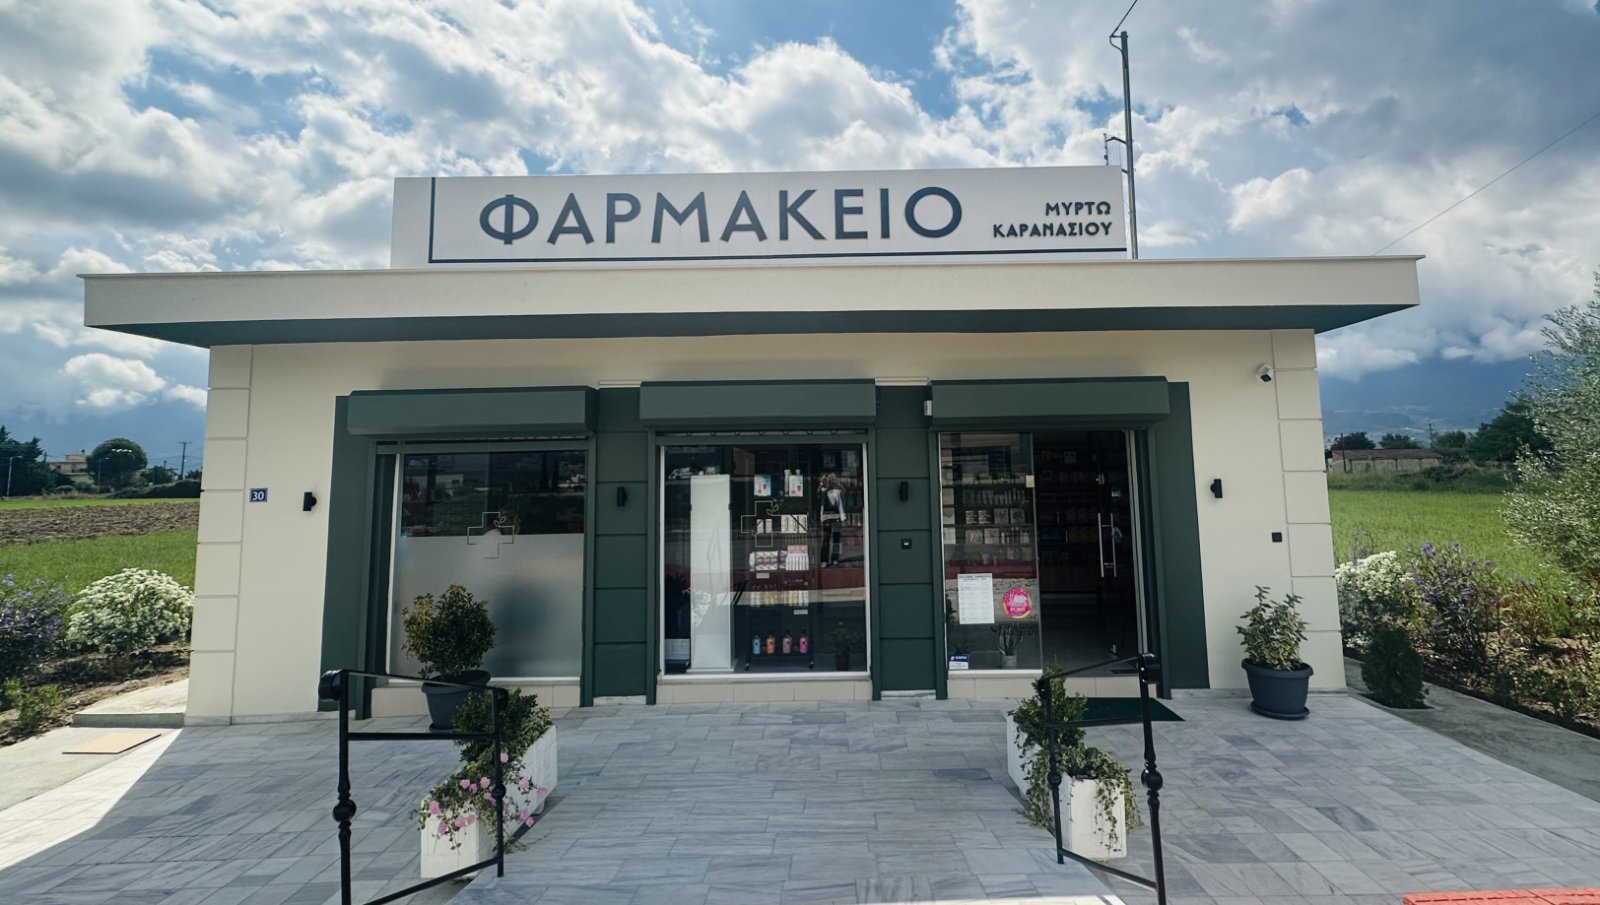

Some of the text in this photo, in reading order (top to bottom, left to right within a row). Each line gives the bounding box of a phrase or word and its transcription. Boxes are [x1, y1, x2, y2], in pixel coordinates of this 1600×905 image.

[479, 186, 963, 245] ΦΑΡΜΑΚΕΙΟ
[1045, 201, 1112, 216] ΜΥΡΤΩ
[992, 221, 1113, 238] ΚΑΡΑΝΑΣΙΟΥ
[252, 491, 265, 501] 30
